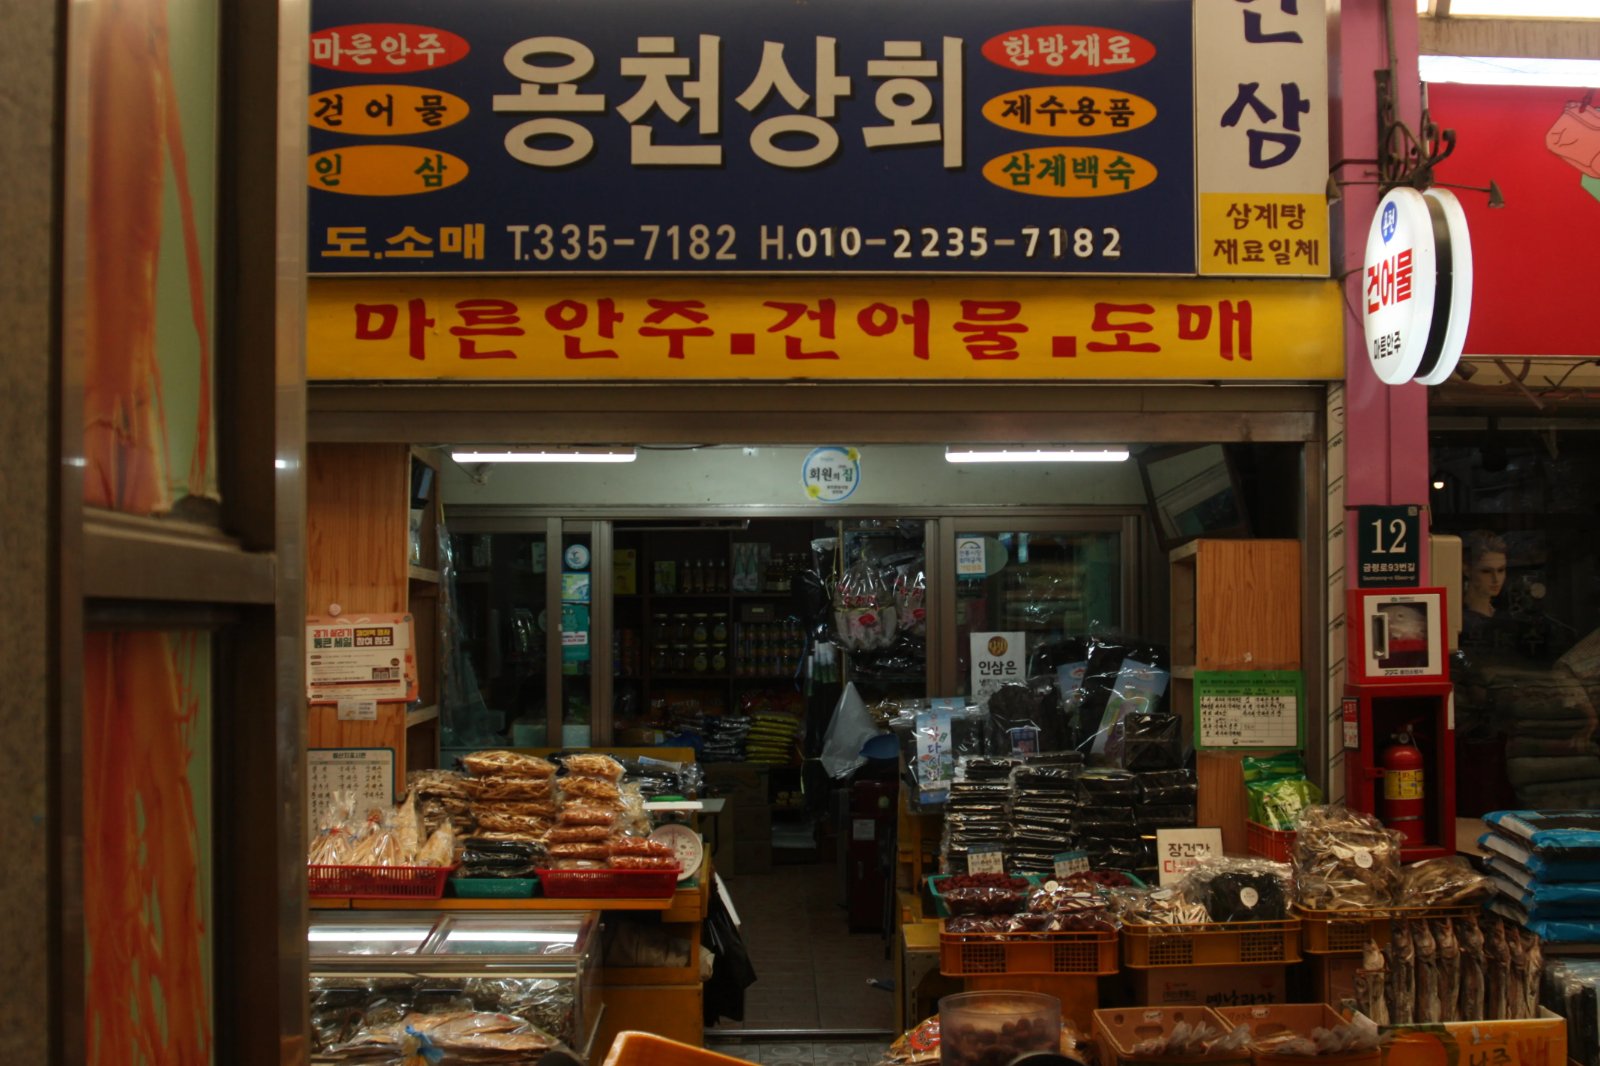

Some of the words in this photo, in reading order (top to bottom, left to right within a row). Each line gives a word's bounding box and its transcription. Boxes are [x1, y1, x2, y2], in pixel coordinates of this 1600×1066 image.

[312, 32, 446, 67] 마른안주
[1002, 34, 1137, 68] 한방재료
[492, 34, 965, 168] 용천상회
[1001, 95, 1136, 128] 제수용품
[1001, 153, 1137, 190] 삼계백숙
[1226, 203, 1306, 230] 삼계탕
[1213, 239, 1319, 266] 재료일체
[1367, 248, 1413, 315] 건어물
[1374, 330, 1402, 359] 마른안주
[1371, 518, 1408, 554] 12
[978, 660, 1018, 676] 인삼은
